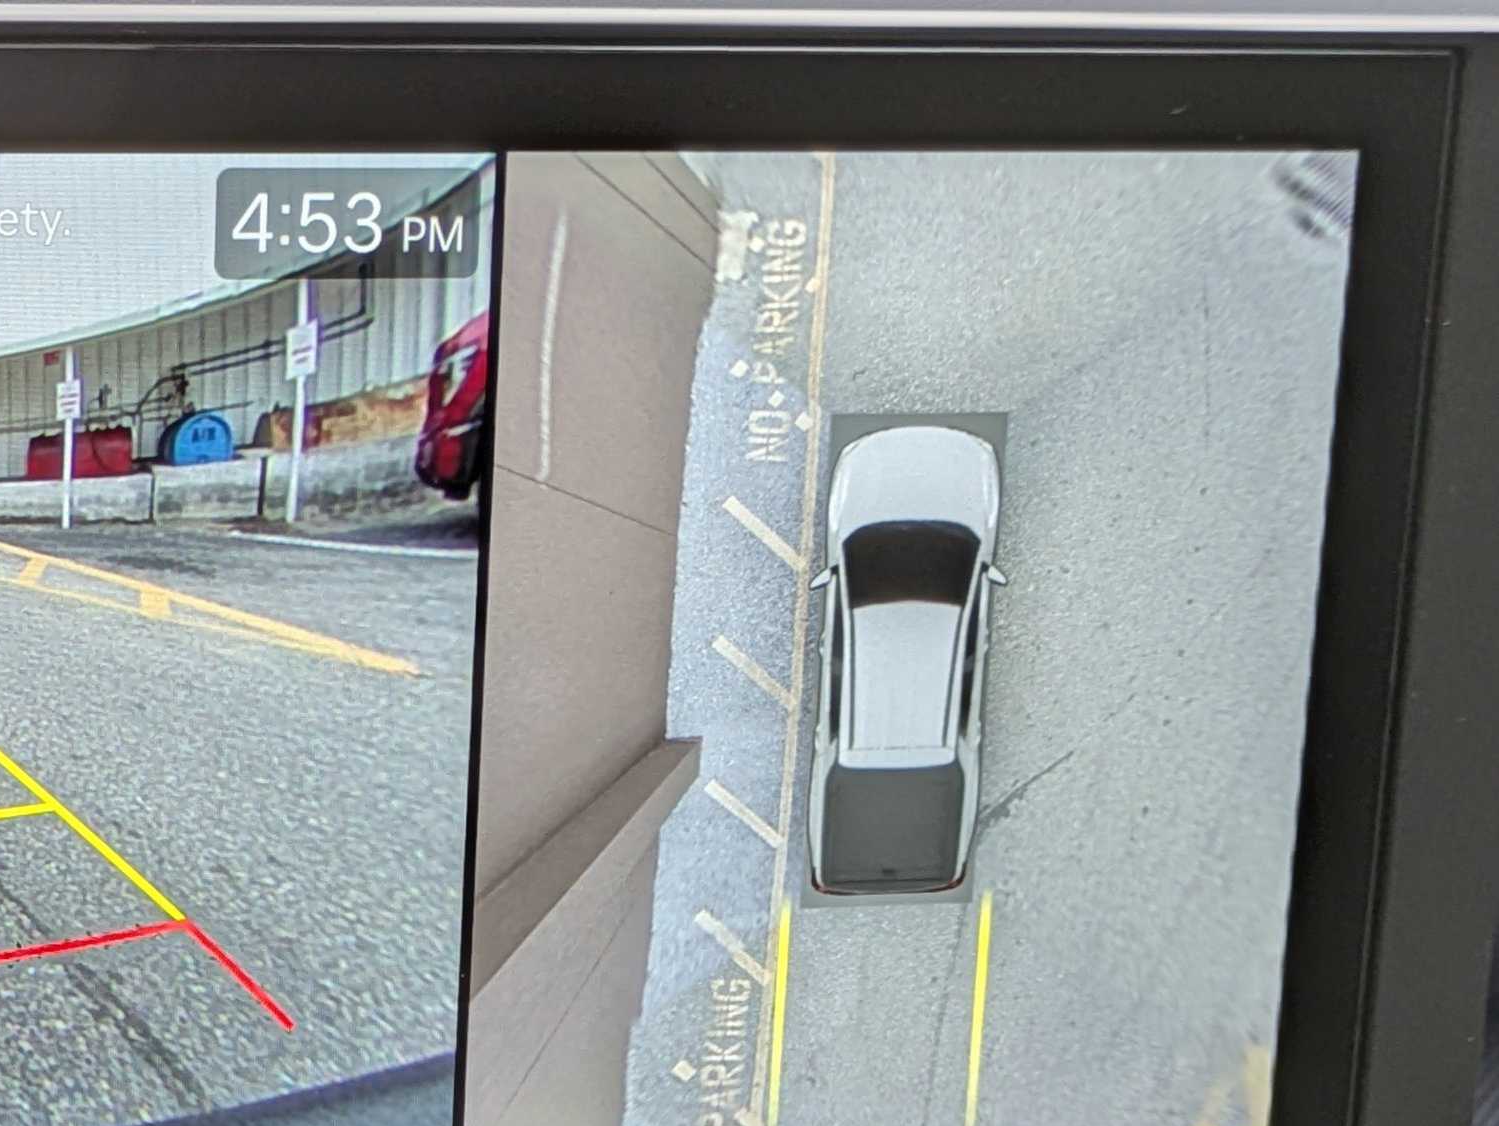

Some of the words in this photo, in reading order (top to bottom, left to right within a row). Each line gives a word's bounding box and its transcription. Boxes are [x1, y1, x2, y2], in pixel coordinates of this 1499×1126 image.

[231, 191, 383, 254] 4:53
[402, 215, 465, 254] PM
[750, 218, 807, 385] PARKING
